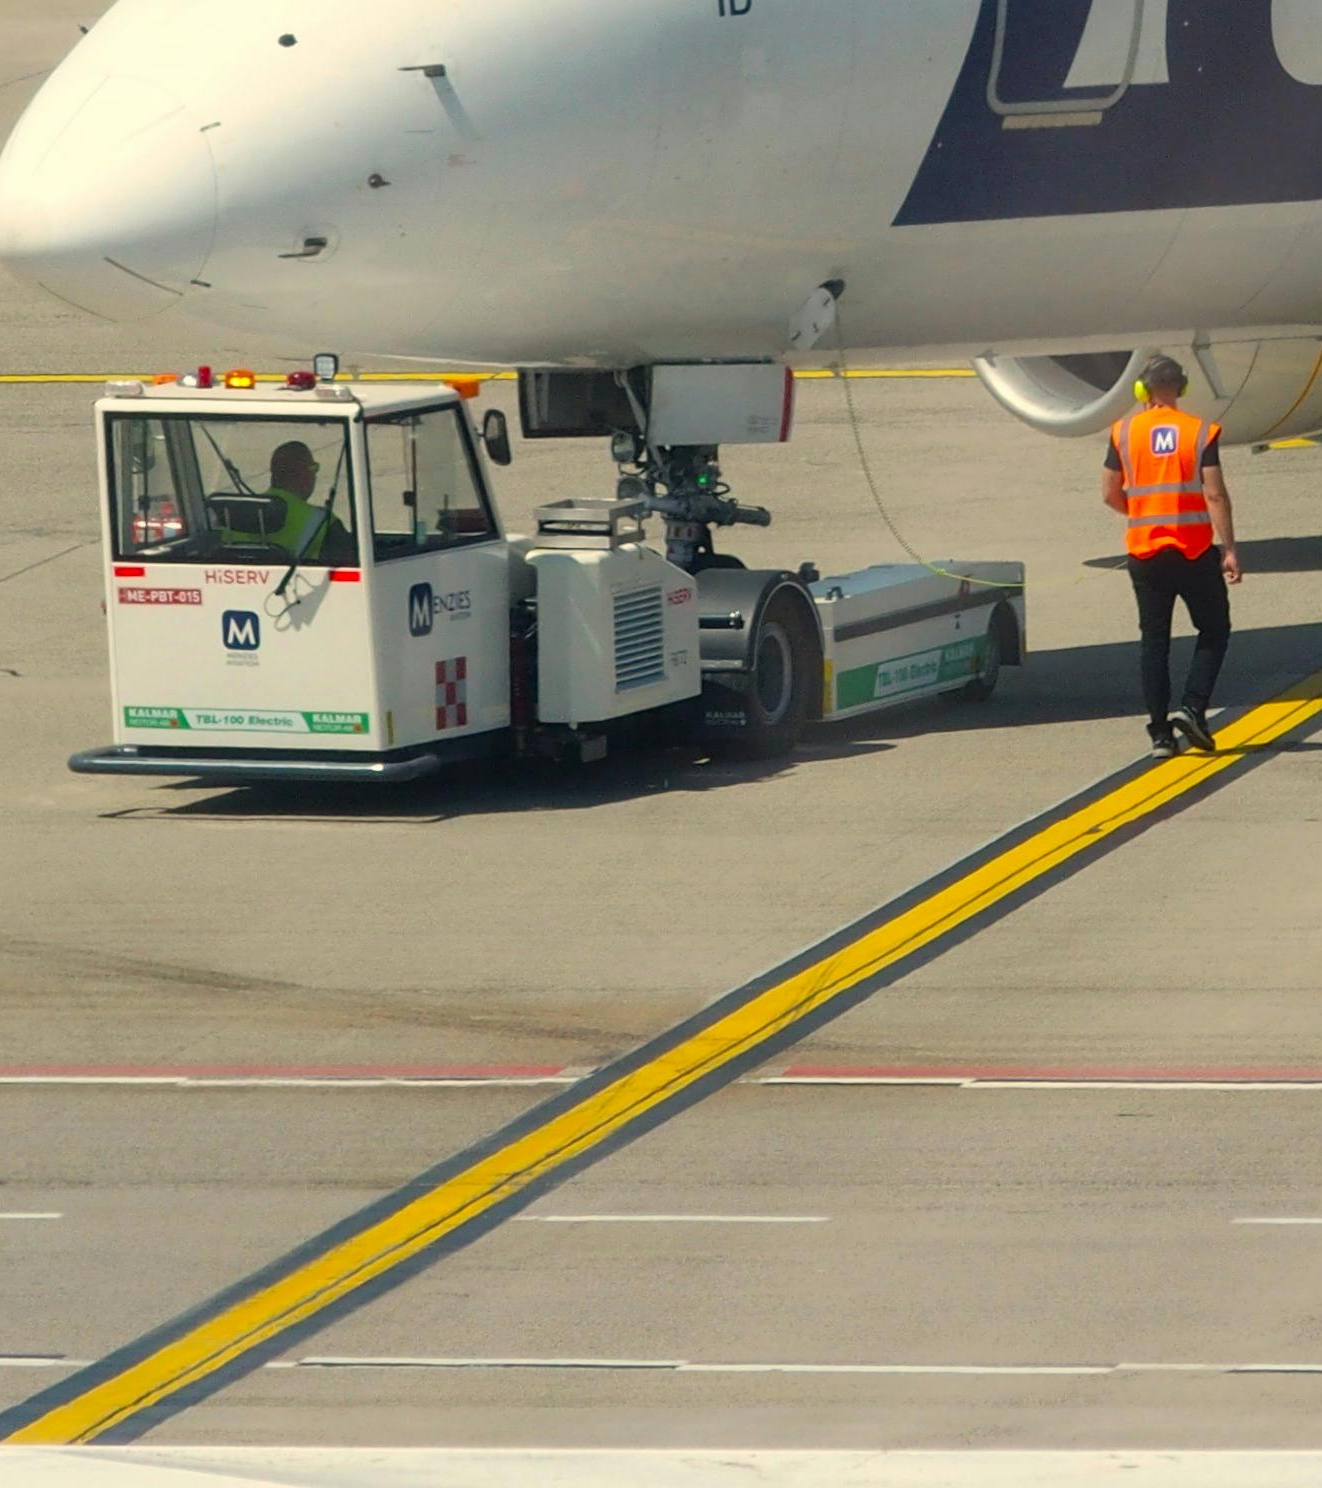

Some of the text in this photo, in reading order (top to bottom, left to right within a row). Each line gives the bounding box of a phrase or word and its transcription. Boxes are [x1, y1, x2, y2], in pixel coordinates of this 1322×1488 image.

[1154, 430, 1175, 452] M
[204, 569, 270, 585] HiSERV
[227, 617, 257, 645] M
[195, 714, 294, 727] TBL-100 Electric
